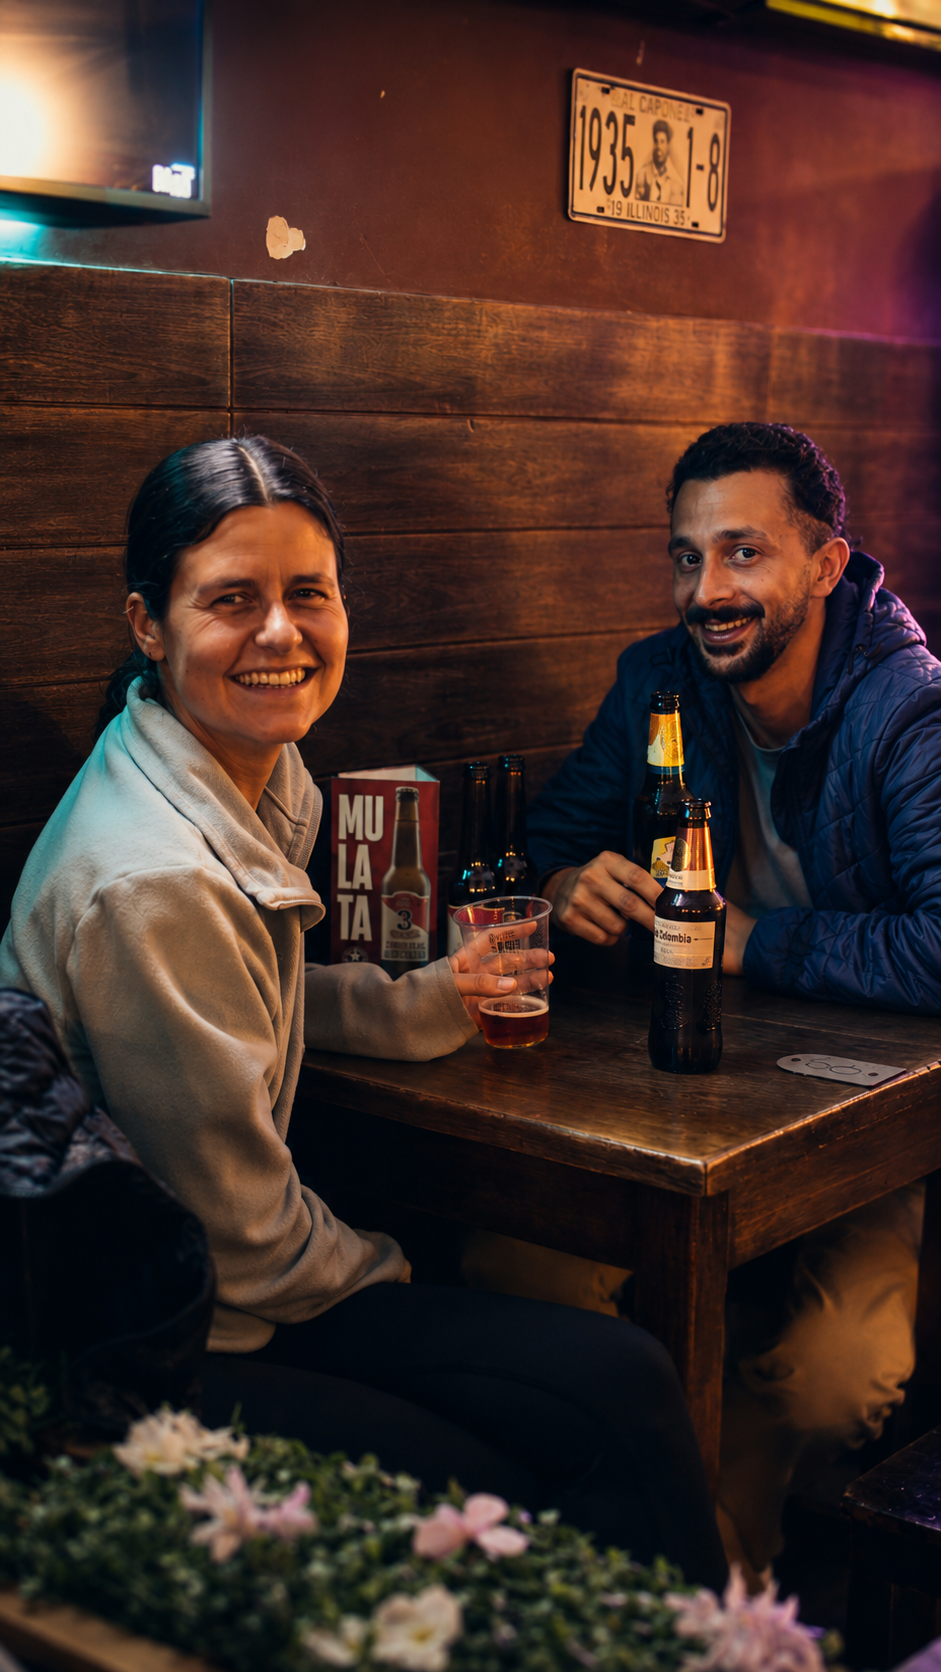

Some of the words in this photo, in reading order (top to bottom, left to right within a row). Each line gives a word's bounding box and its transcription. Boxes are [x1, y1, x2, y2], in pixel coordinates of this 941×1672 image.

[620, 92, 636, 111] AL
[579, 105, 636, 198] 1935
[686, 126, 720, 212] 1-8
[610, 199, 623, 217] 19
[626, 202, 670, 224] ILLINOIS
[673, 209, 686, 226] 35
[338, 794, 384, 842] MU
[337, 843, 373, 891] LA
[337, 894, 372, 942] TA
[397, 909, 412, 931] 3
